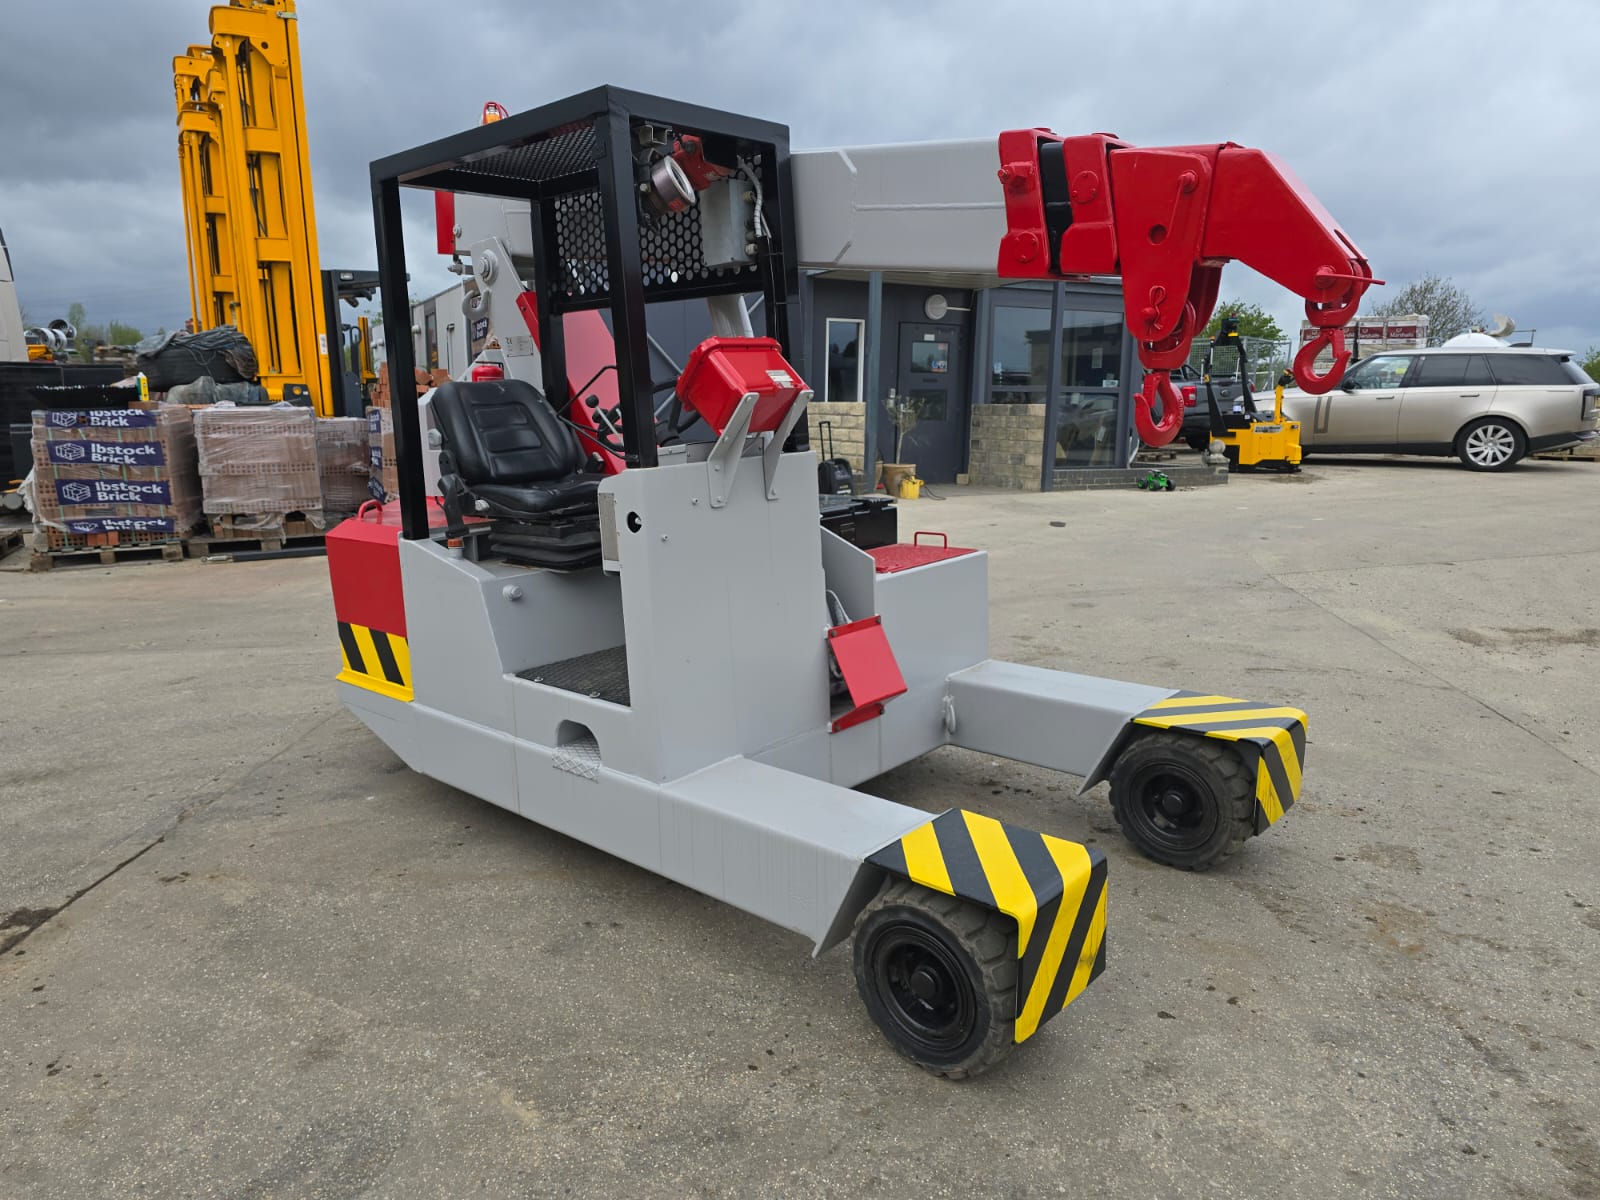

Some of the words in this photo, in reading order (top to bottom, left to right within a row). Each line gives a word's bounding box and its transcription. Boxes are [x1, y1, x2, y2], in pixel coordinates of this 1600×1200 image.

[90, 416, 130, 427] Brick
[91, 443, 156, 455] Ibstock
[91, 453, 137, 464] Brick
[95, 481, 163, 494] Ibstock
[97, 491, 142, 502] Brick
